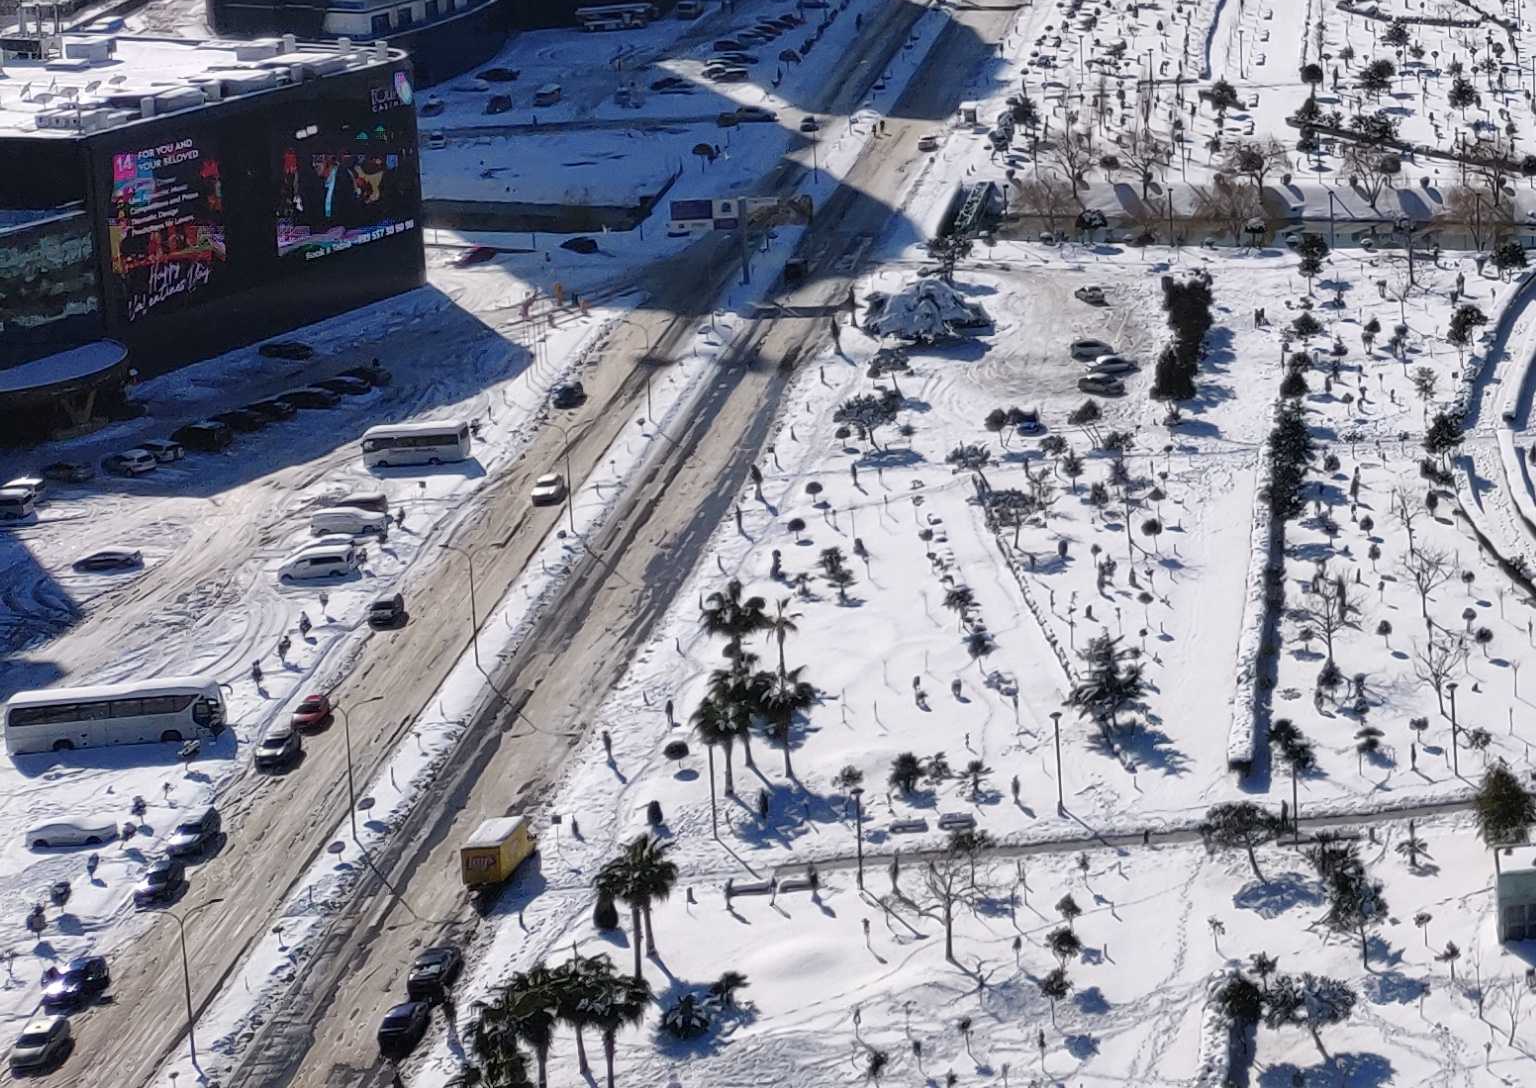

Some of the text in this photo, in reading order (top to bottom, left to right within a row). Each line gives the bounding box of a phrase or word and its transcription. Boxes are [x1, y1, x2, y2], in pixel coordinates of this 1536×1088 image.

[138, 138, 193, 160] FOR YOU AND
[139, 149, 199, 171] YOUR BELOVED
[149, 261, 180, 293] Happy
